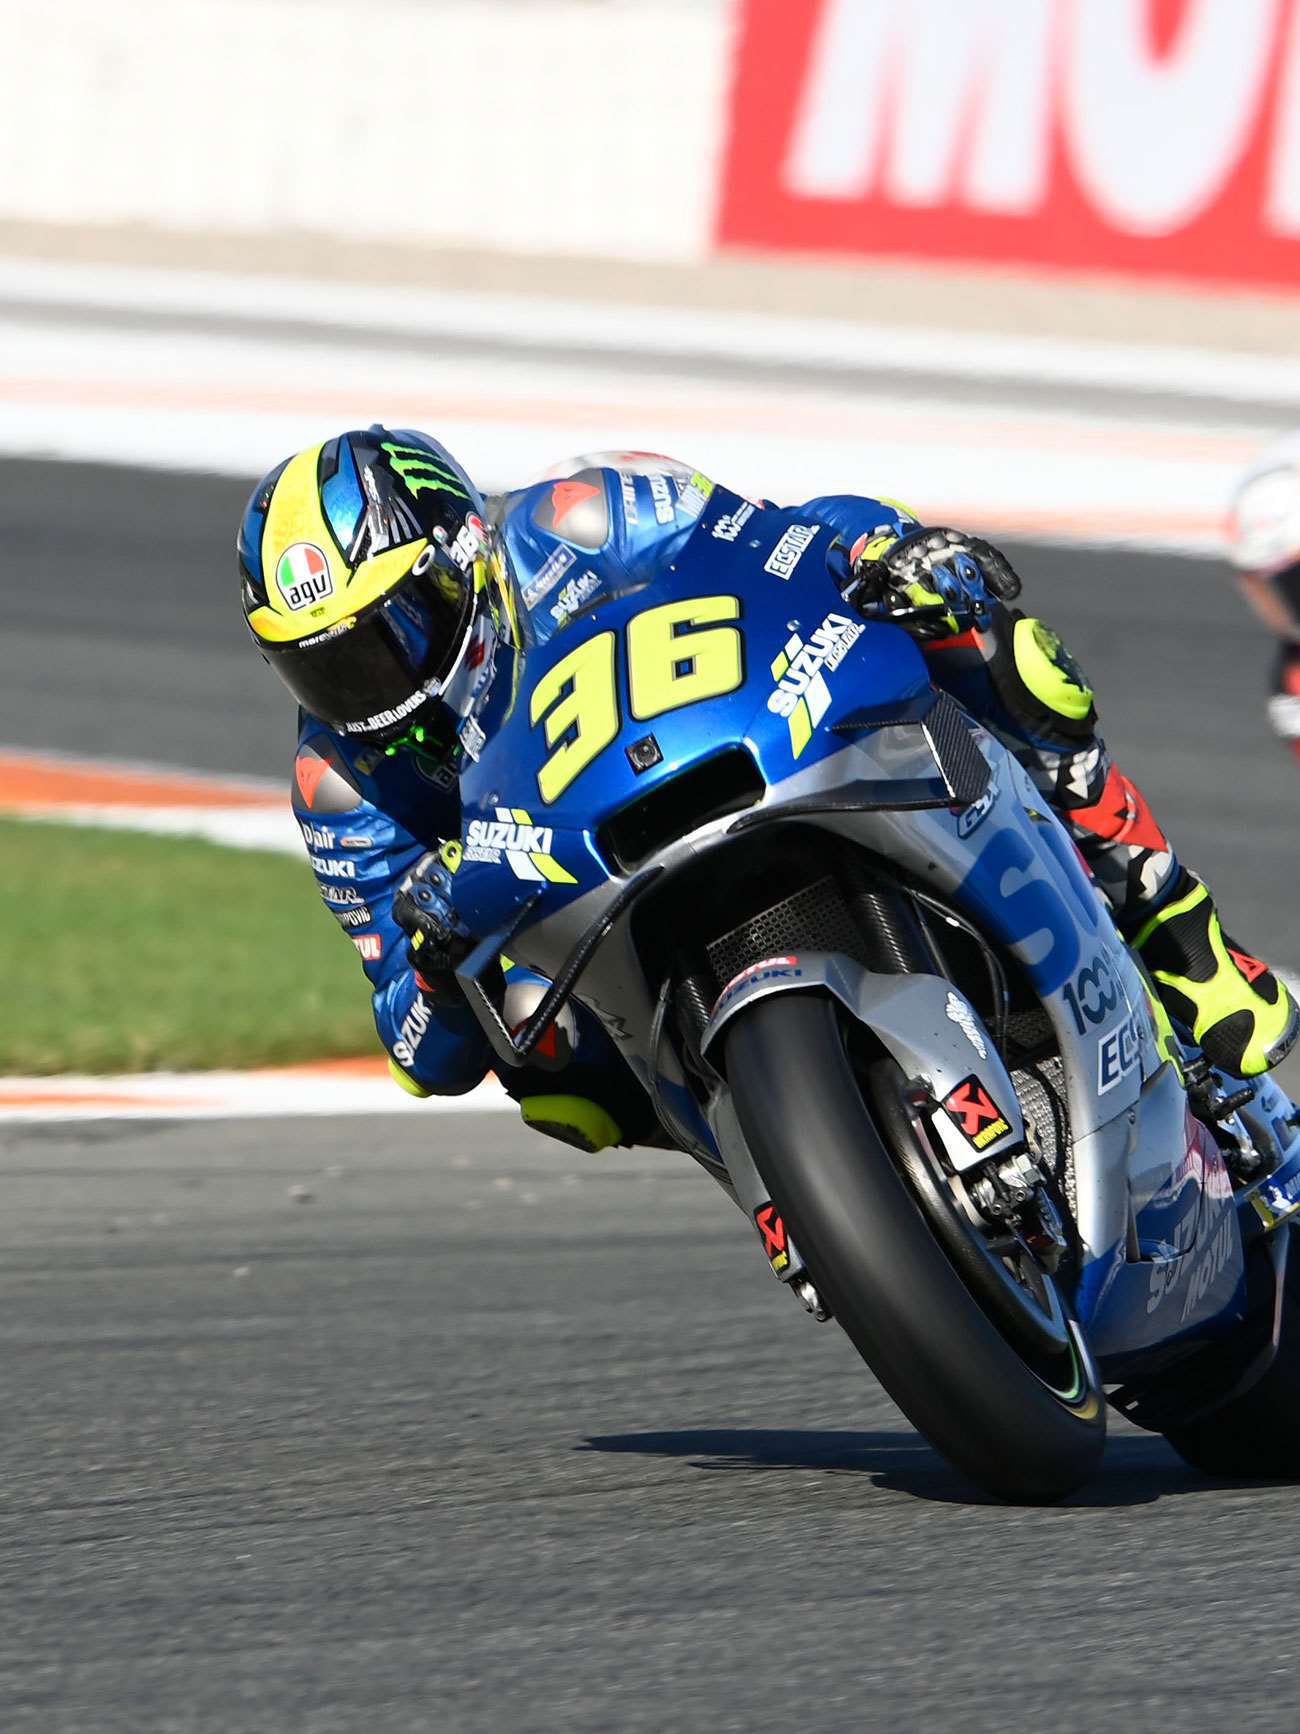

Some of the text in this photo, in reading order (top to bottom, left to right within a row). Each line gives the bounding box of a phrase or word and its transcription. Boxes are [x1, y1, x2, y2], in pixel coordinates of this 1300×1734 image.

[289, 574, 326, 604] agv
[530, 594, 744, 805] 36
[767, 612, 854, 717] SUZUKI
[466, 819, 553, 854] SUZUKI
